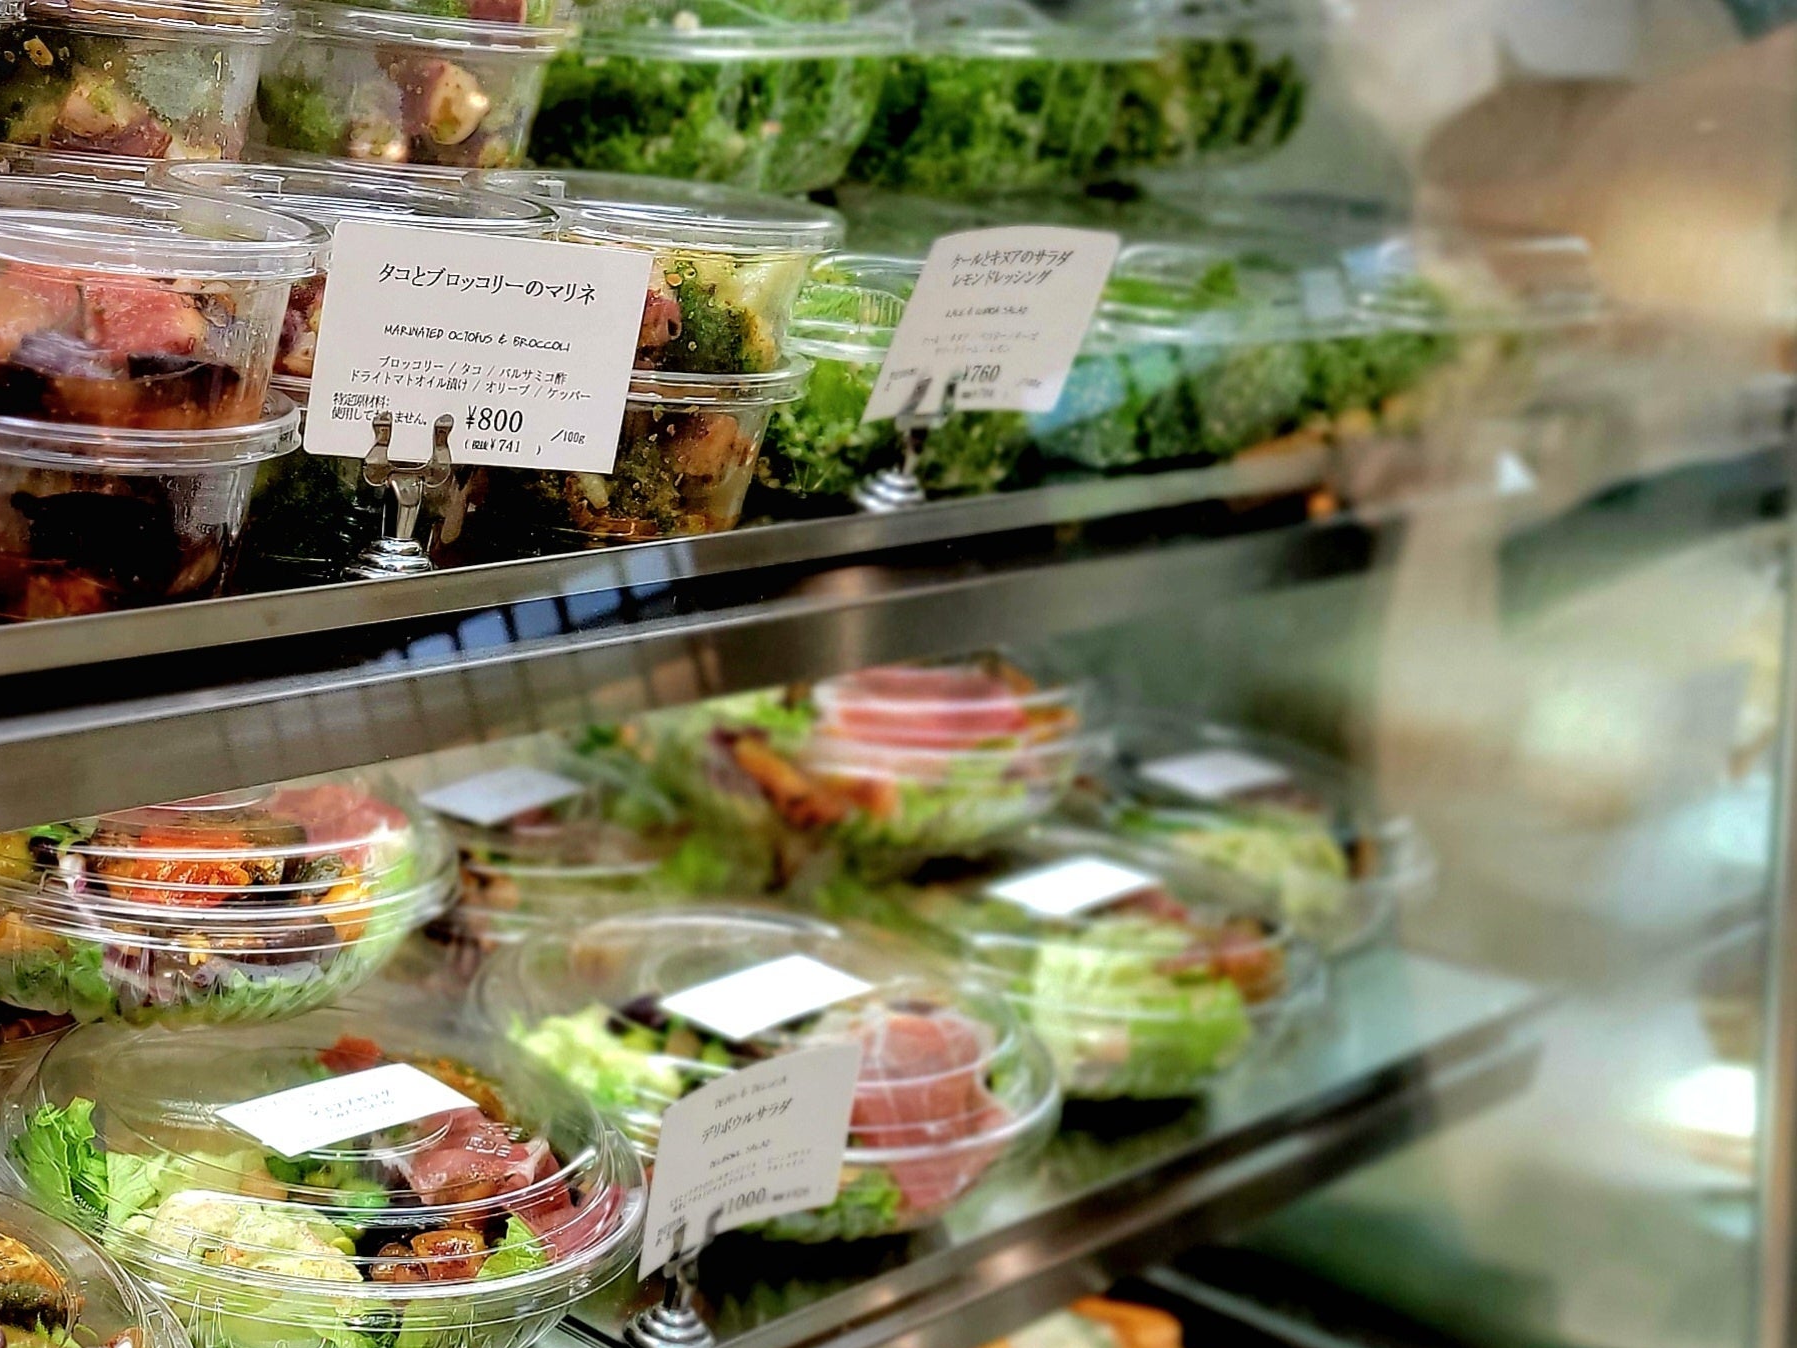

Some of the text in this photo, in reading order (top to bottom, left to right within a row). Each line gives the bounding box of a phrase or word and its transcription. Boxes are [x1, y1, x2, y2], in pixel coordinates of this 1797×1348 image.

[377, 262, 597, 306] タコとブロッコリーのマリネ
[384, 323, 444, 340] MARINATED
[497, 332, 508, 345] &
[512, 335, 571, 353] BROCCOLI
[378, 355, 444, 373] ブロッコリー
[462, 362, 483, 376] タコ
[961, 363, 1002, 383] ¥760
[485, 380, 531, 396] オリーブ
[546, 386, 591, 401] ケッパー
[331, 405, 428, 427] 使用してません。
[465, 405, 587, 445] ¥800 /100g
